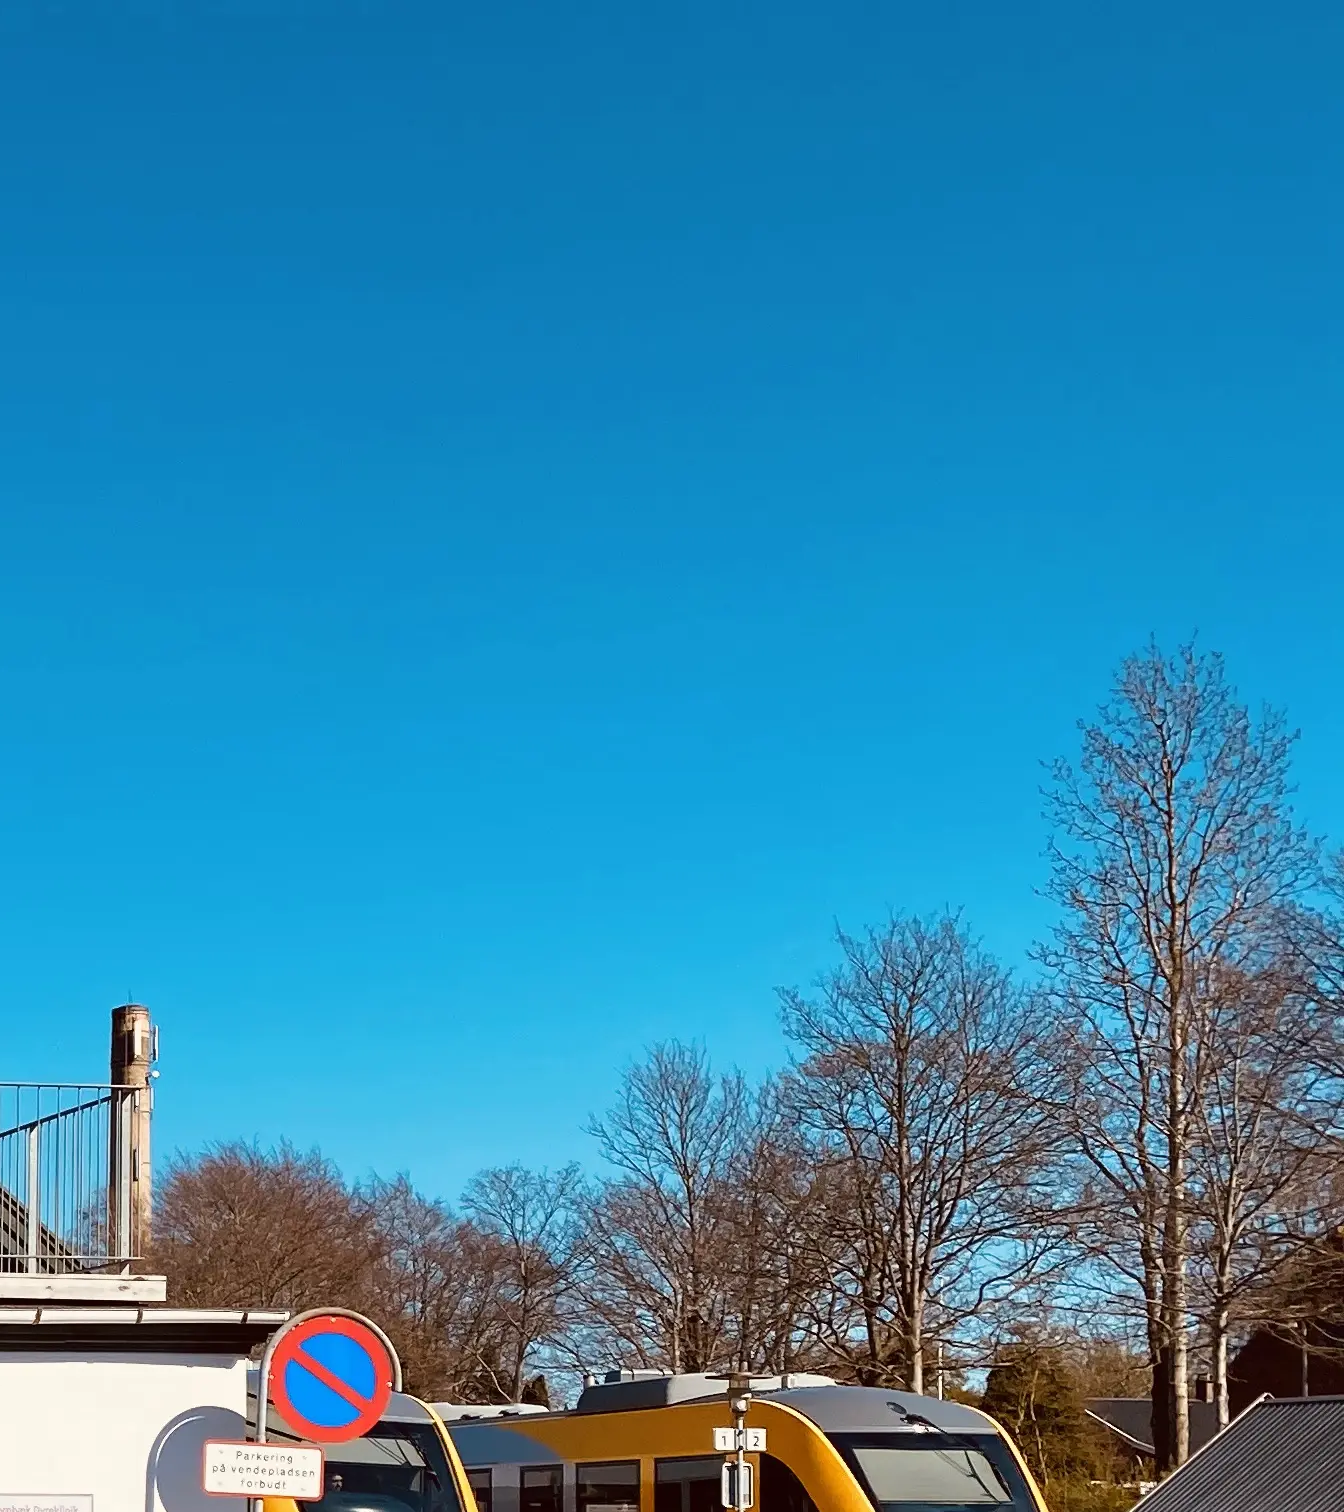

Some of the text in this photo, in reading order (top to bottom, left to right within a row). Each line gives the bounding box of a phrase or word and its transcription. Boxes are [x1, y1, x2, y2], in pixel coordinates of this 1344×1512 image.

[721, 1436, 726, 1446] 1
[753, 1436, 759, 1446] 2
[236, 1450, 293, 1464] Parkering
[212, 1463, 315, 1477] på vendepladsen
[241, 1479, 287, 1489] forbudt
